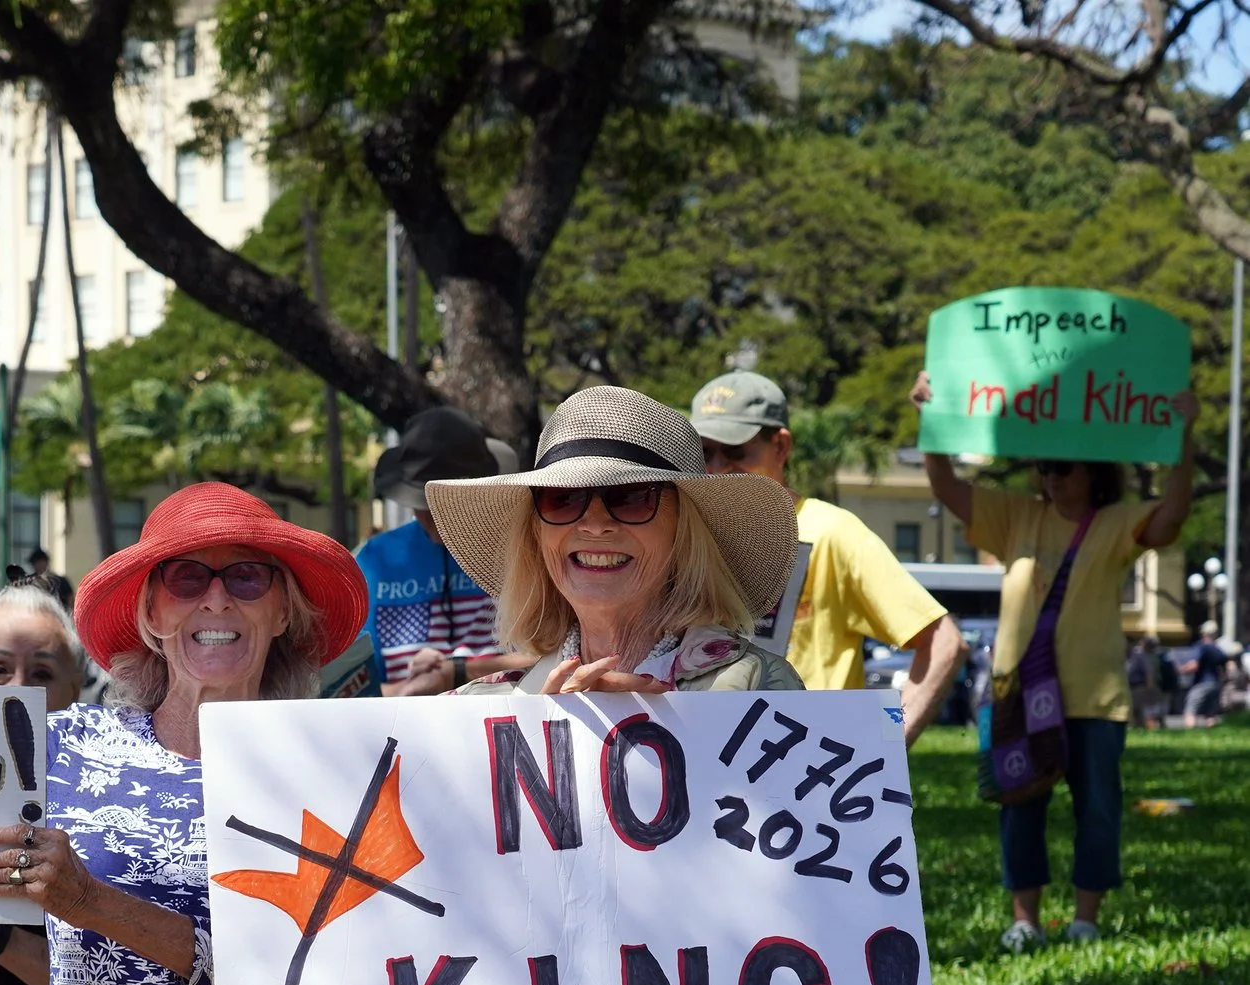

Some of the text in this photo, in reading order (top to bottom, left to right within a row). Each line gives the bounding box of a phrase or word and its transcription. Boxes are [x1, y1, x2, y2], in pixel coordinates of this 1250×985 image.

[973, 301, 1128, 344] Impeach
[966, 374, 1060, 425] mad
[484, 711, 691, 856] NO
[717, 697, 912, 824] 1776-
[714, 794, 911, 897] 2026
